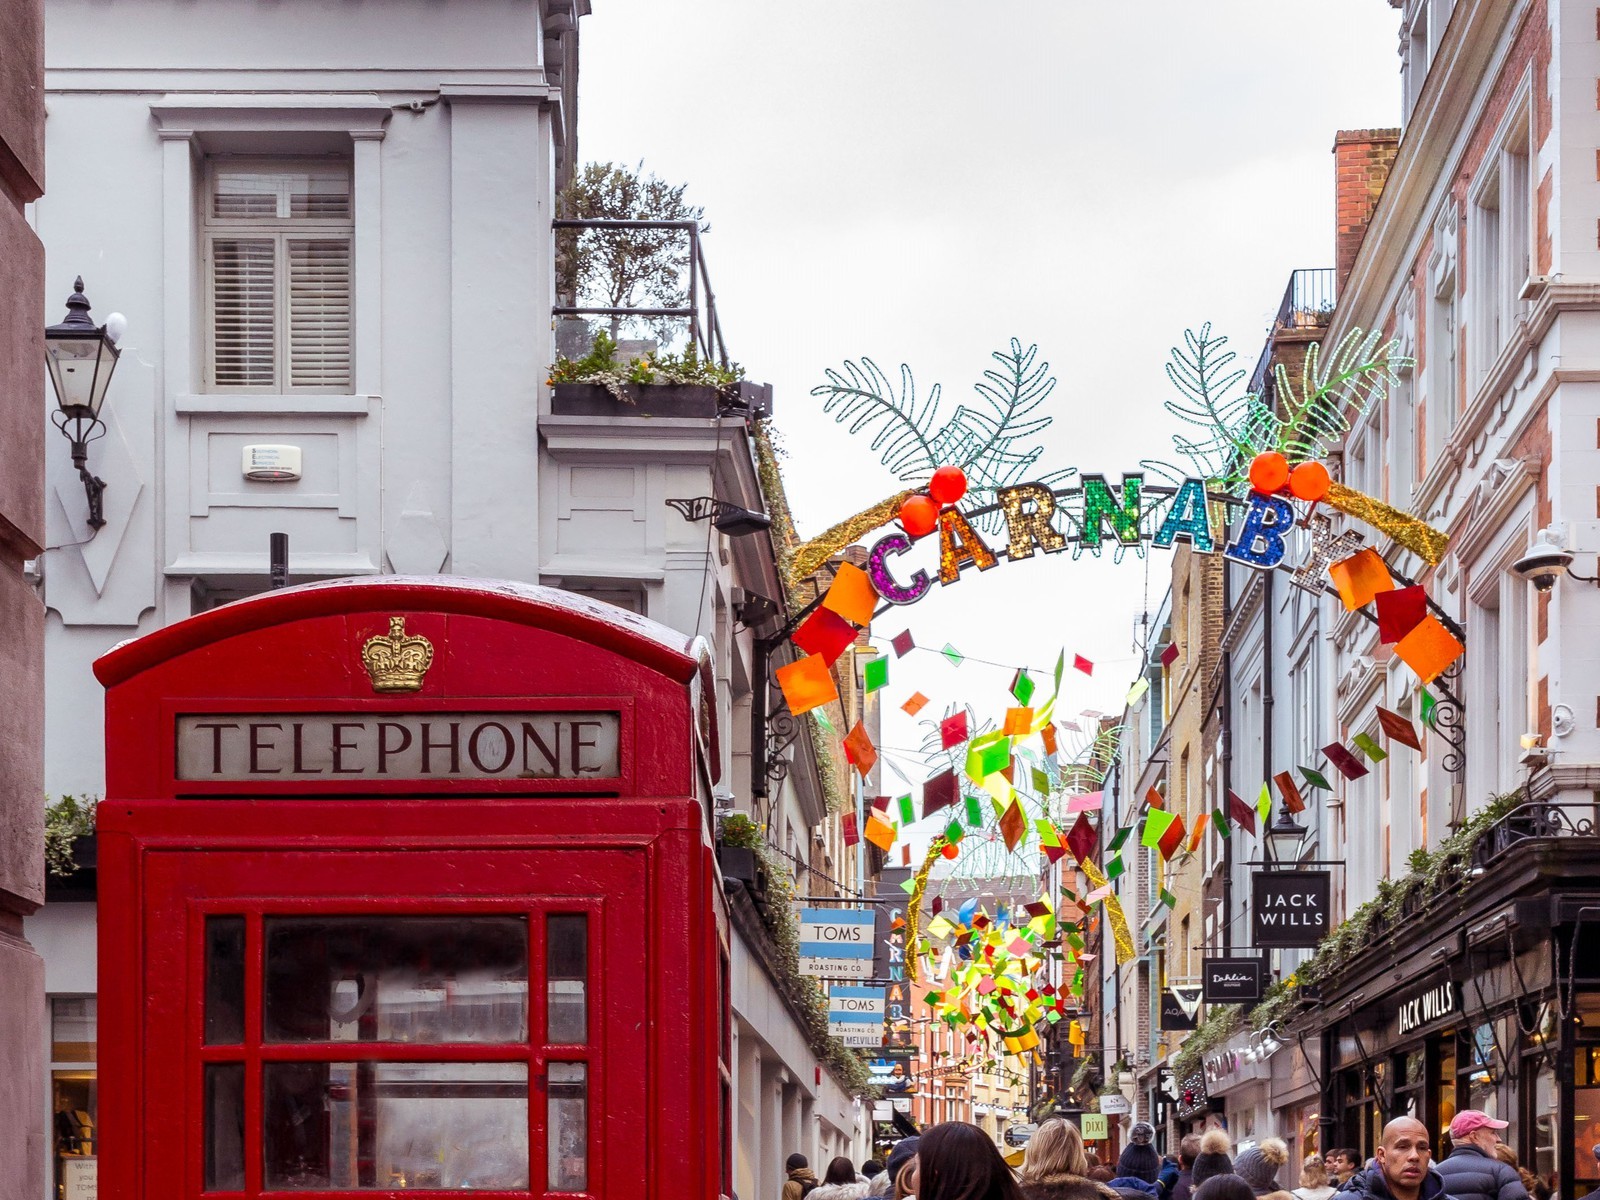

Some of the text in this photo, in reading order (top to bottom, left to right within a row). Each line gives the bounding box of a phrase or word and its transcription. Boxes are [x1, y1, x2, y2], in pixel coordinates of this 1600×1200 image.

[867, 471, 1367, 605] CARNABY
[194, 720, 603, 775] TELEPHONE
[1265, 893, 1318, 908] JACK
[1260, 912, 1323, 926] WILLS
[813, 925, 861, 942] TOMS
[808, 963, 848, 972] ROASTING
[889, 907, 904, 1040] CARNAB
[839, 999, 875, 1012] TOMS
[1398, 981, 1453, 1035] JACK WILLS
[846, 1036, 880, 1046] MELVILLE
[1085, 1117, 1104, 1135] pixi
